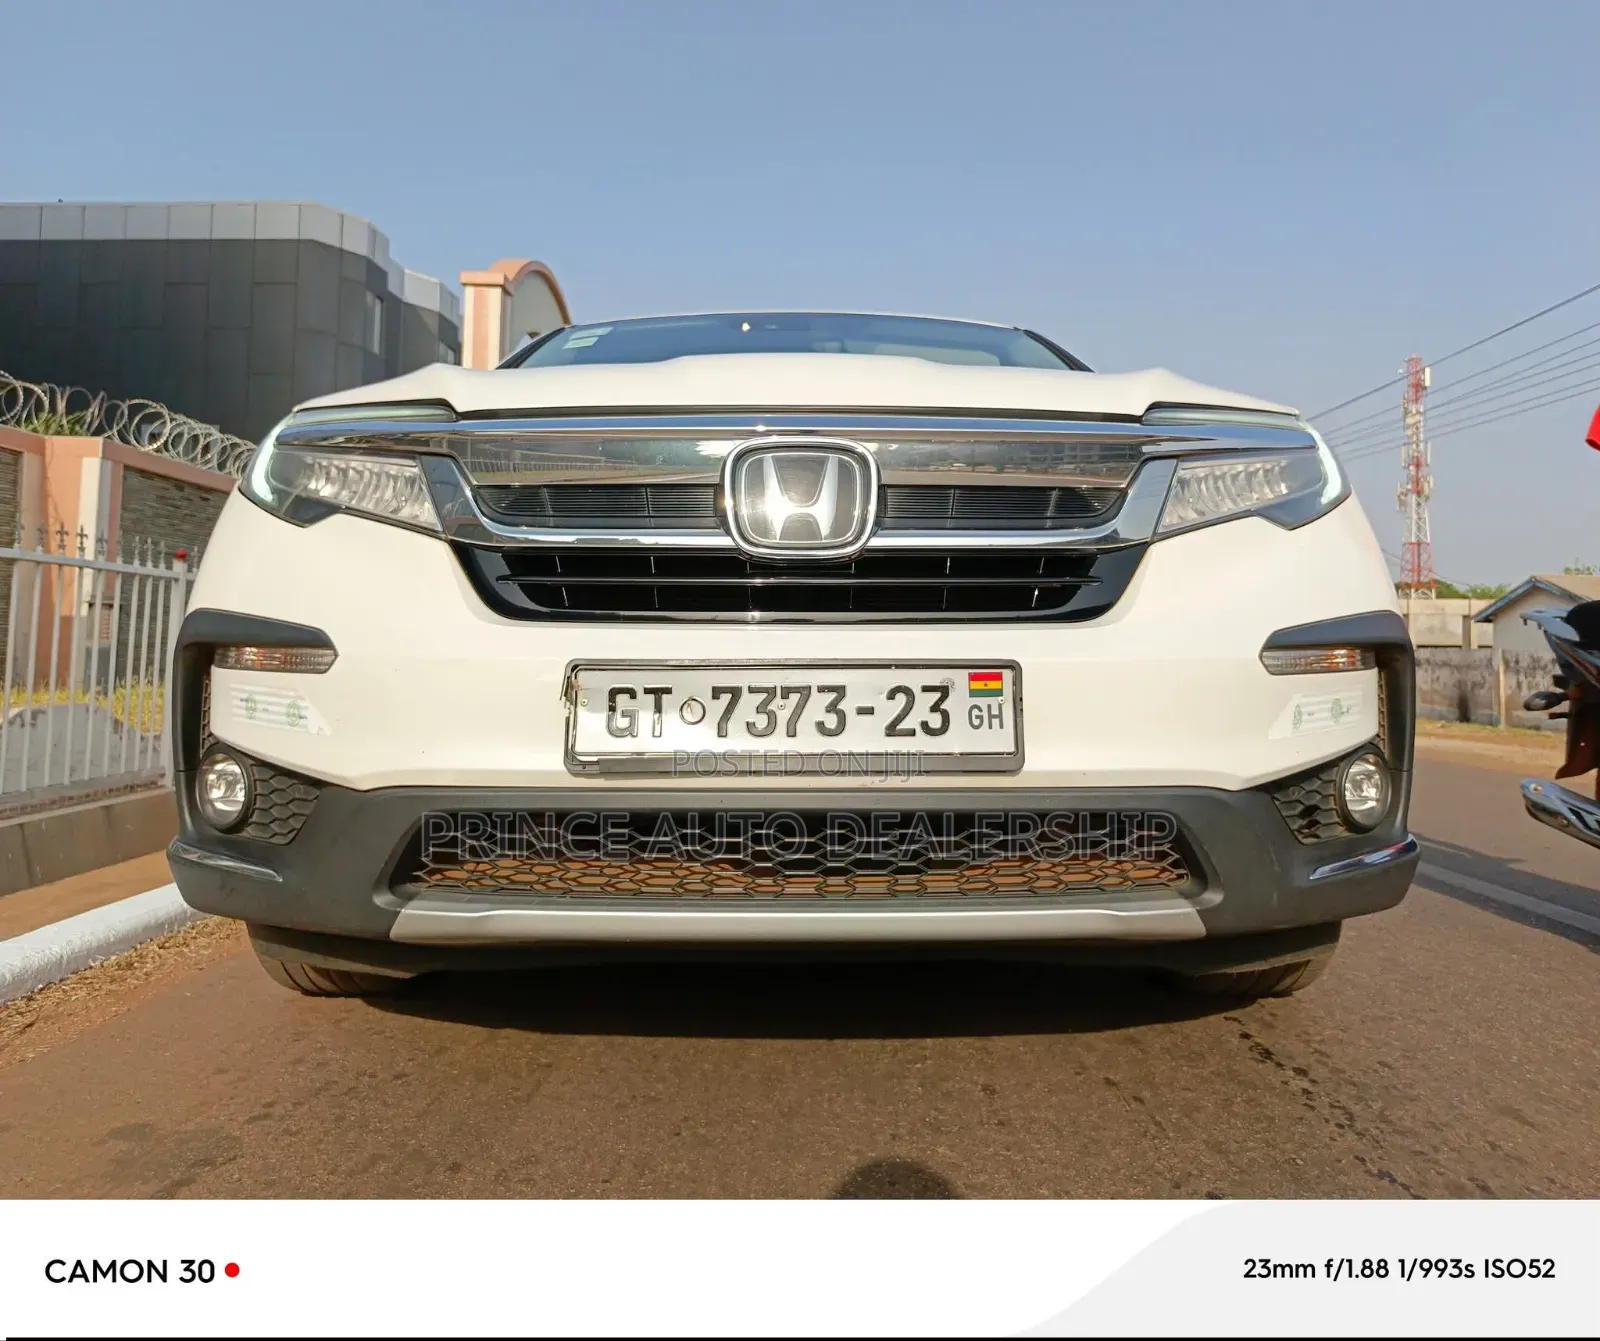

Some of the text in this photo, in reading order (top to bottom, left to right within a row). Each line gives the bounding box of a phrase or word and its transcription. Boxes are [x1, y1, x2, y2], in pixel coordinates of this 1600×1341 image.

[607, 683, 950, 738] GT 7373-23
[967, 703, 1005, 730] GH
